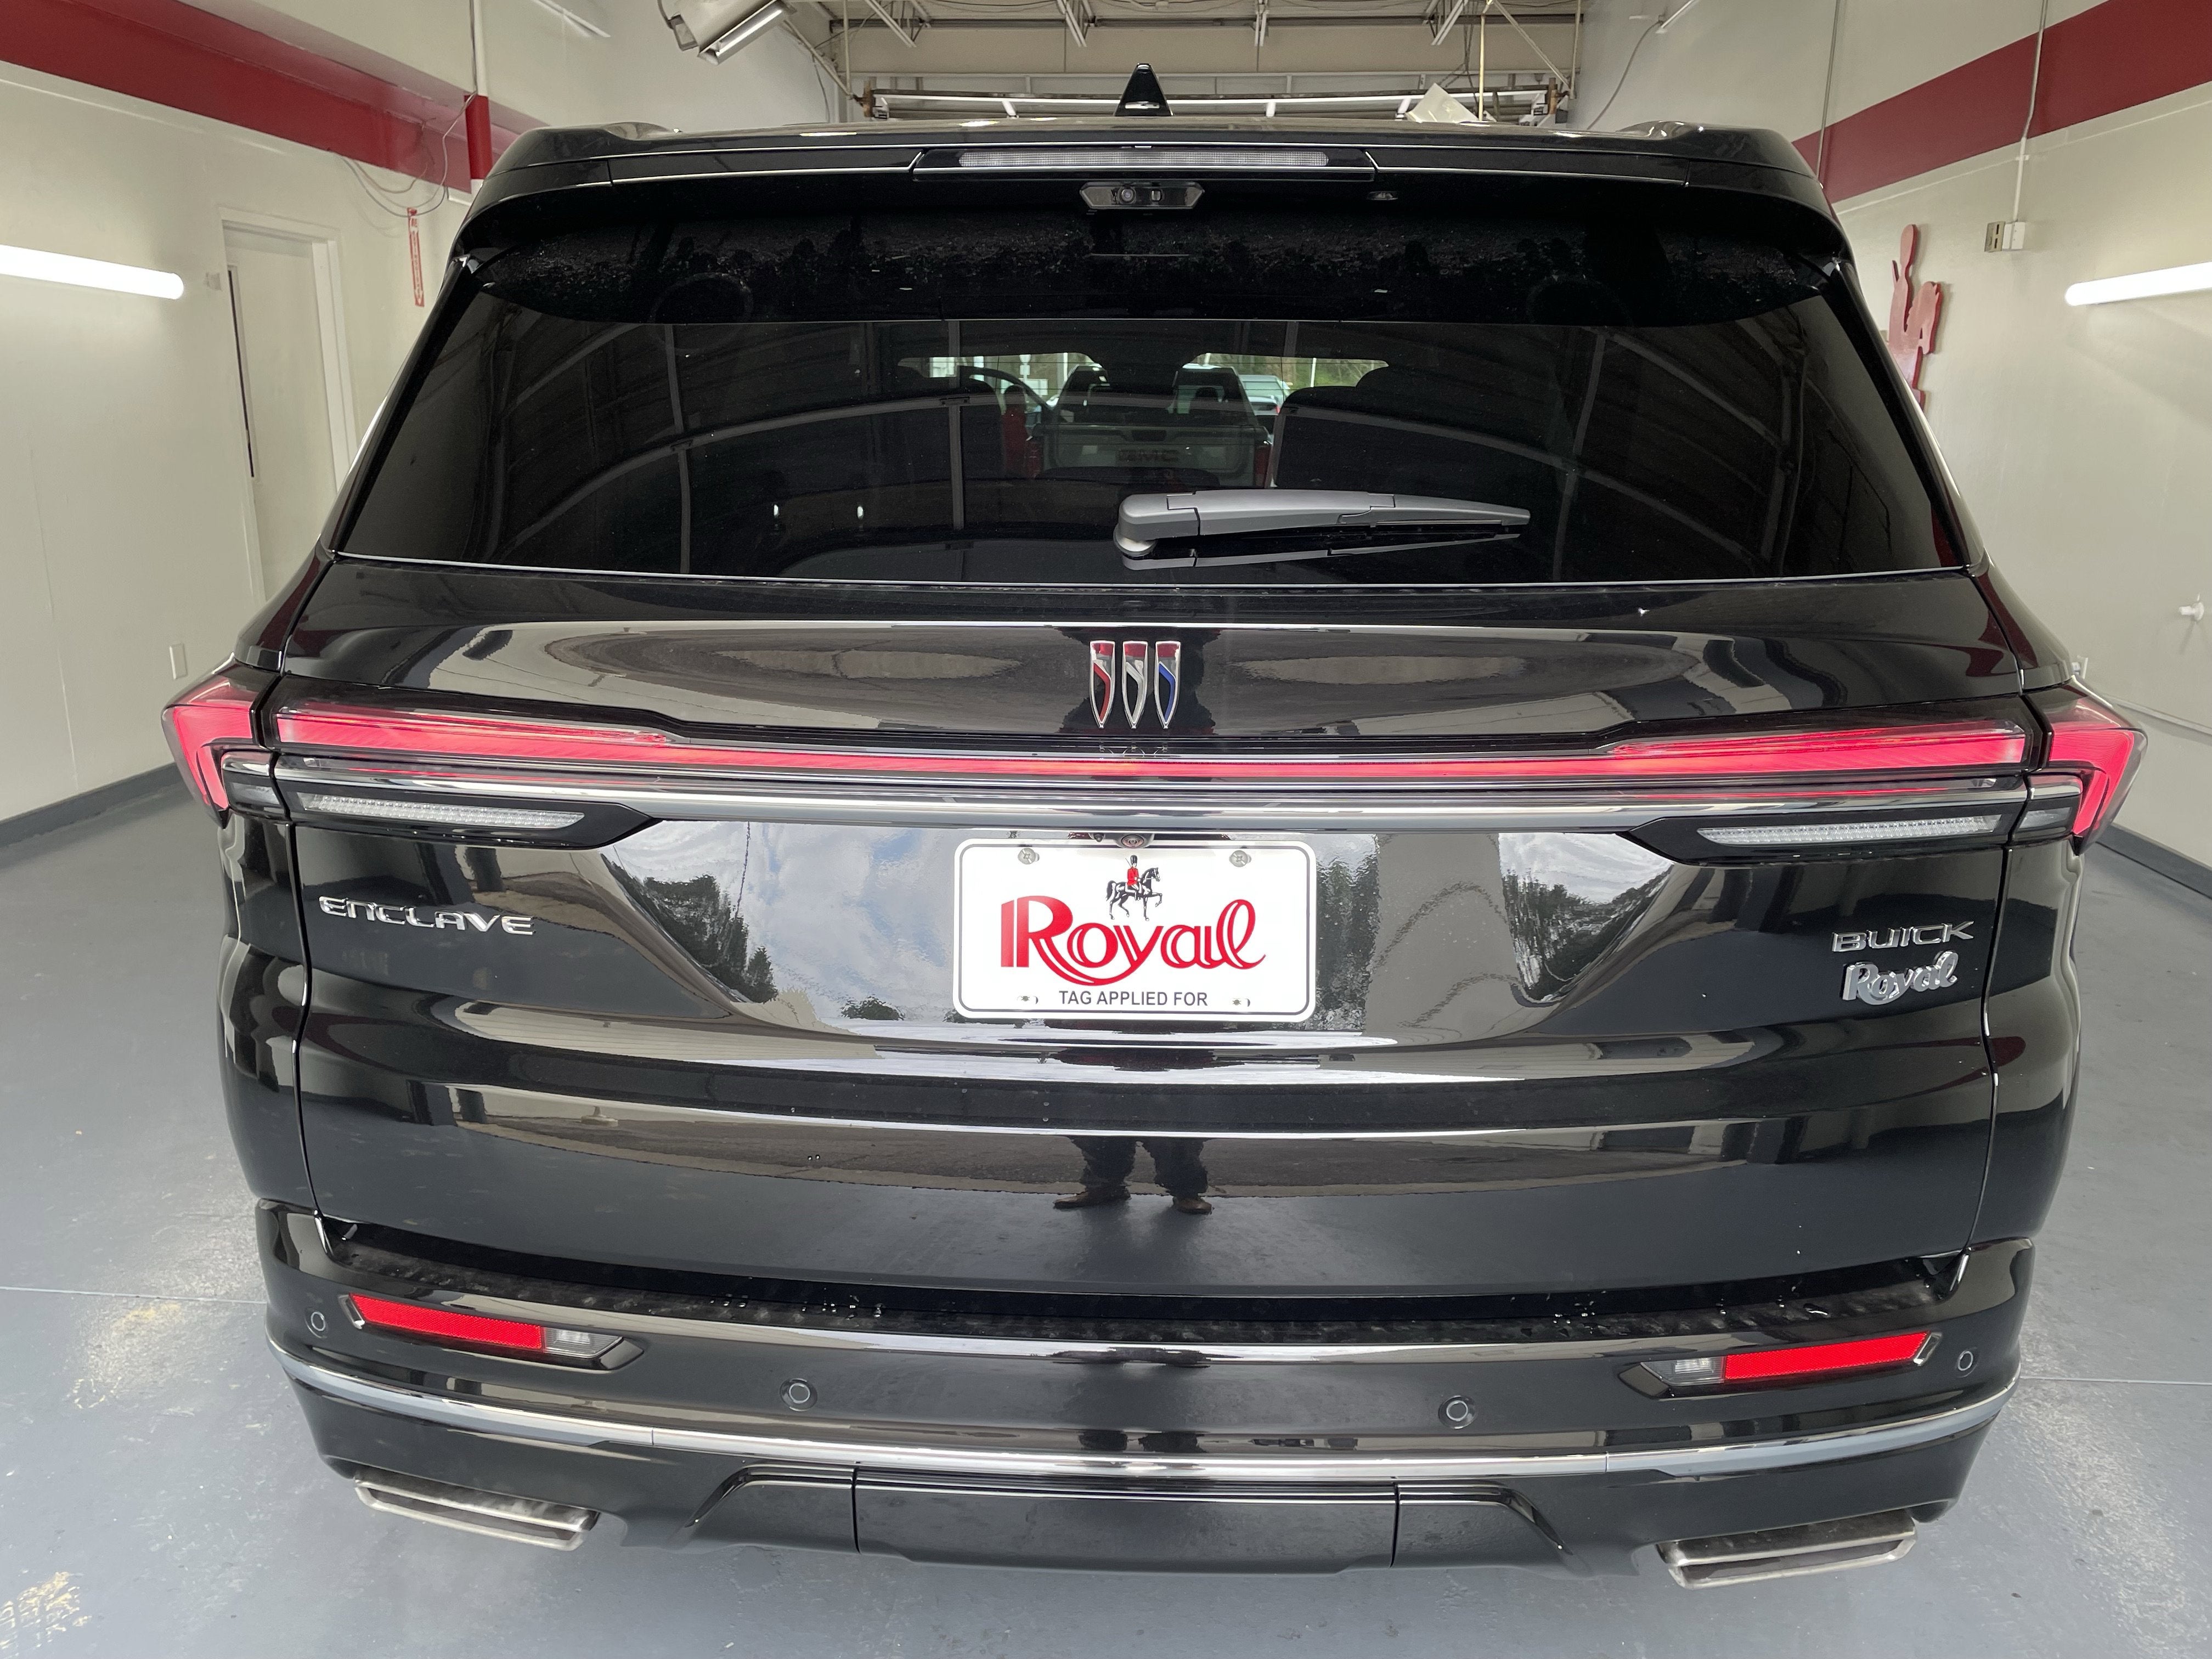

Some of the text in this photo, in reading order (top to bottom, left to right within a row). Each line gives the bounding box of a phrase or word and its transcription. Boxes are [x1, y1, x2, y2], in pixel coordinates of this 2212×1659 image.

[319, 895, 537, 935] ENCLAVE
[1001, 895, 1267, 986] Royal
[1832, 921, 1974, 952] BUICK
[1840, 950, 1959, 1005] Royal
[1059, 990, 1208, 1006] TAG APPLIED FOR
